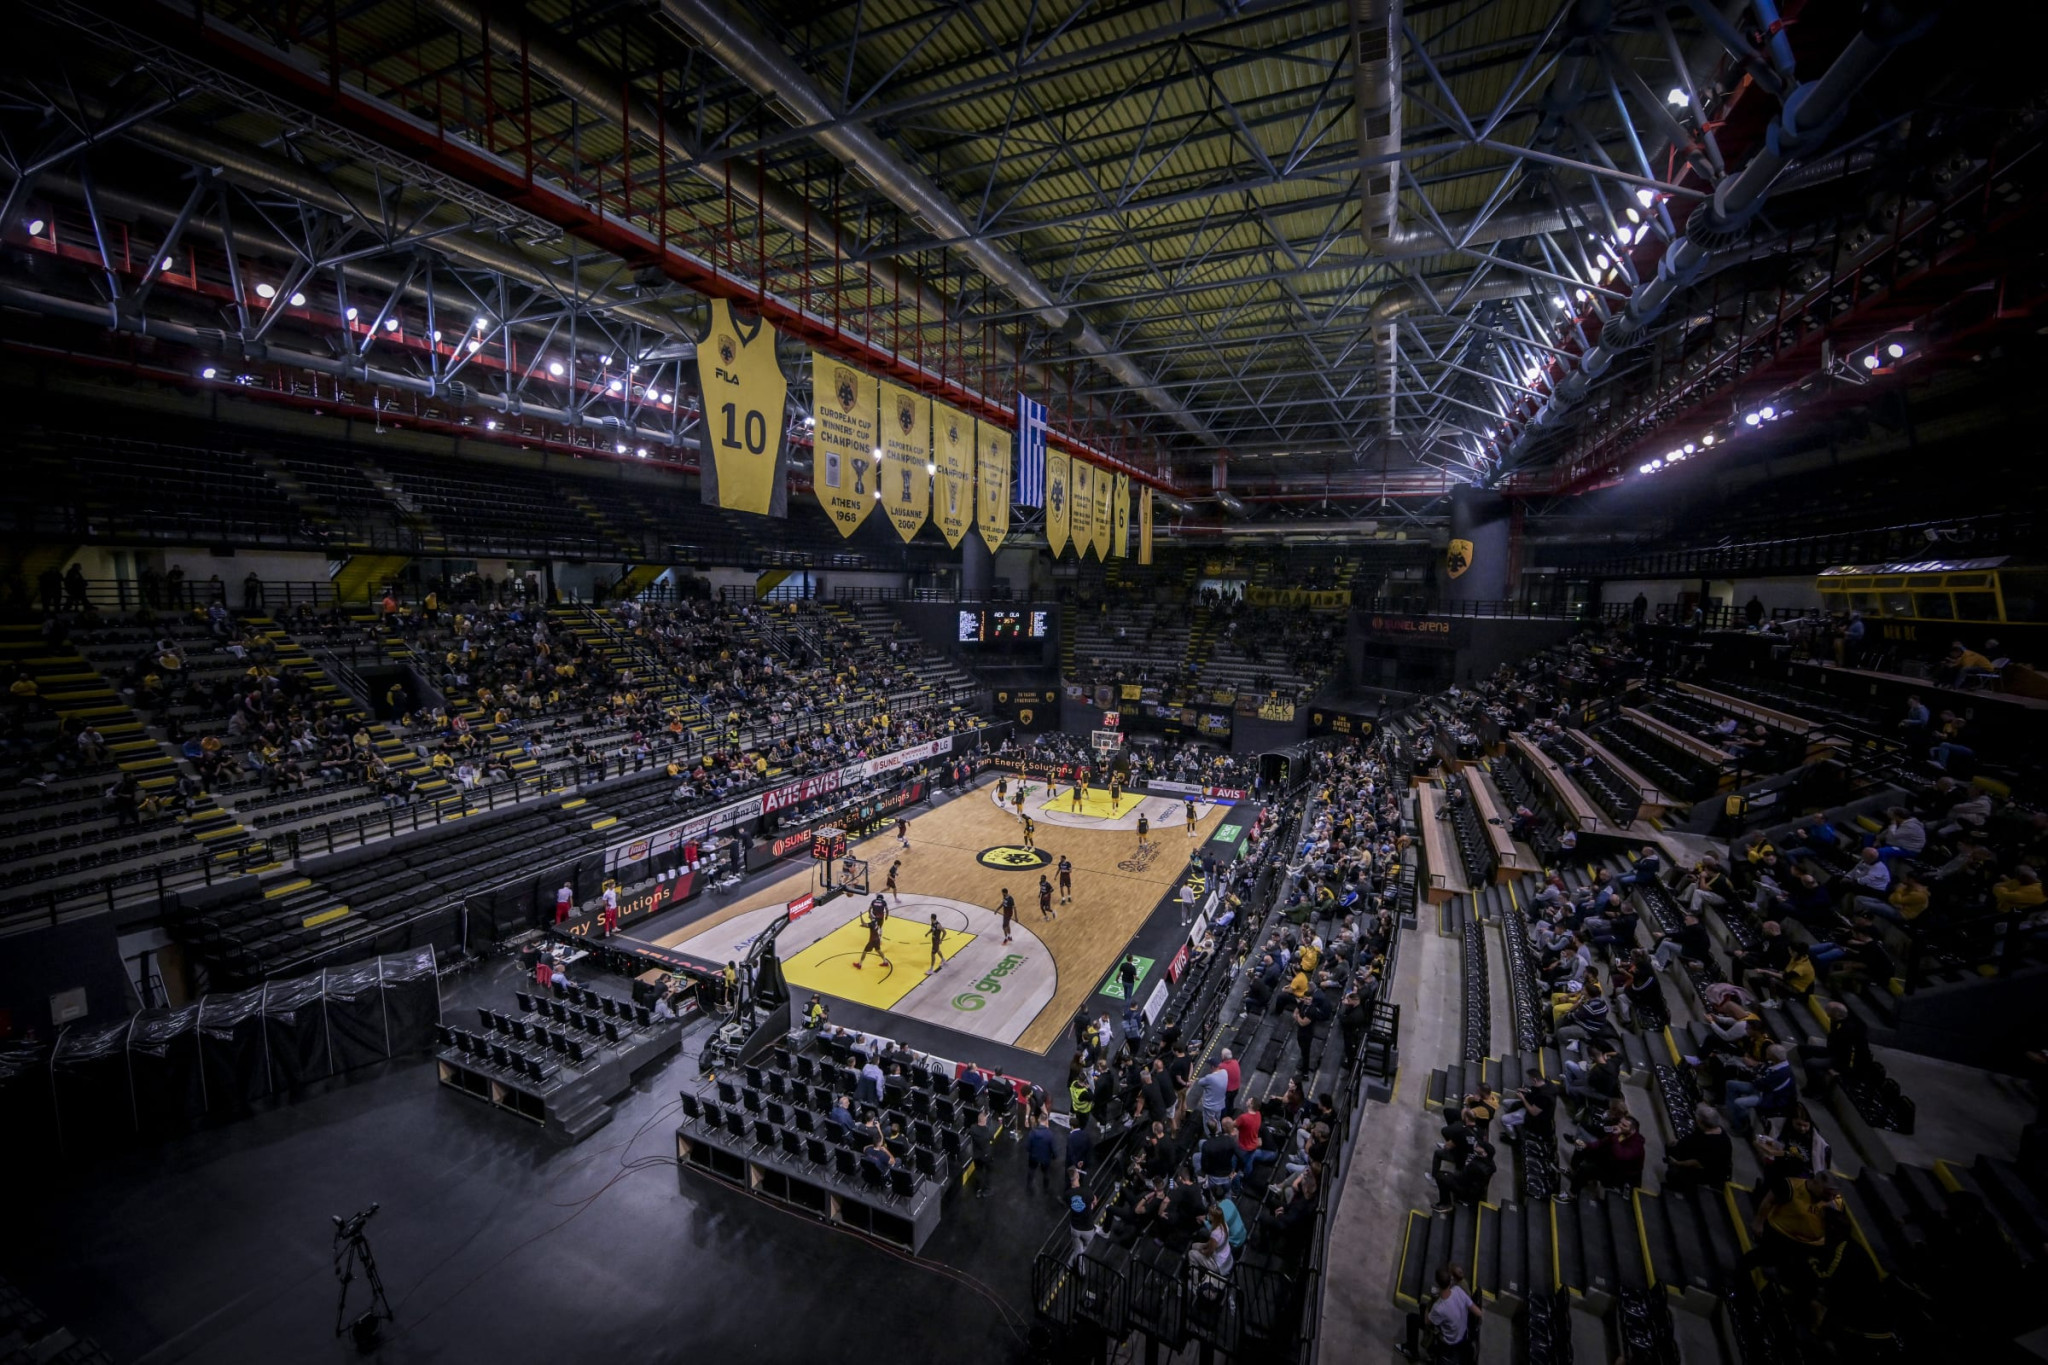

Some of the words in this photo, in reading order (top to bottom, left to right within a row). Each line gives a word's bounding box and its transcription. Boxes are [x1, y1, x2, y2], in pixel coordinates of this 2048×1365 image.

[715, 367, 740, 386] FILA
[820, 406, 857, 425] EUROPEAN
[858, 419, 871, 430] CUP
[721, 402, 766, 455] 10
[856, 430, 870, 440] CUP
[821, 431, 870, 453] CHAMPIONS
[887, 450, 926, 467] CHAMPIONS
[913, 446, 924, 455] CUP
[832, 496, 861, 510] ATHENS
[836, 510, 857, 522] 1968
[890, 507, 922, 519] LAUSANNE
[1119, 508, 1125, 529] 6
[898, 519, 916, 530] 2000
[1418, 621, 1450, 633] arena
[940, 740, 948, 750] LG
[879, 756, 901, 770] SUNEL
[766, 784, 800, 812] AVIS
[806, 772, 837, 798] AVIS
[1217, 788, 1240, 799] AVIS
[881, 792, 910, 809] olutions
[722, 806, 750, 824] Allianz
[813, 844, 829, 858] 24
[832, 841, 846, 857] 24
[596, 888, 671, 926] Slutions
[1174, 949, 1188, 979] AVIS
[974, 954, 1024, 994] green
